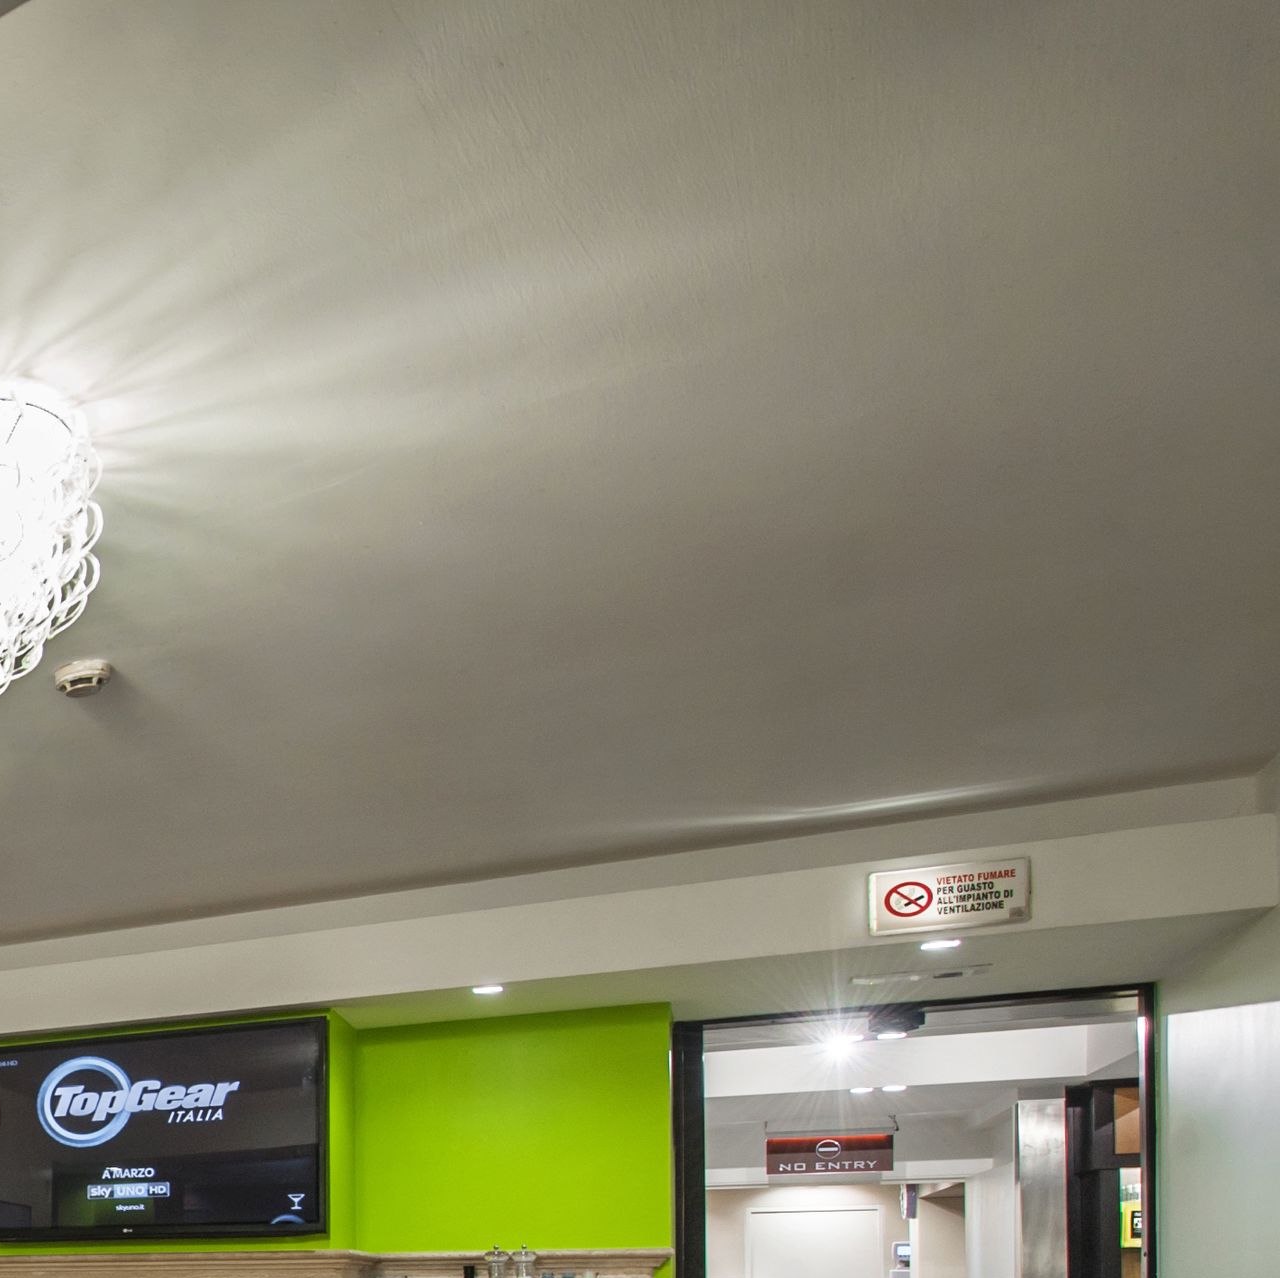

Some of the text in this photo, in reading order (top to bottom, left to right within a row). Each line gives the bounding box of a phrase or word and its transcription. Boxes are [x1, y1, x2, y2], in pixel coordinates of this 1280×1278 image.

[936, 868, 1017, 886] VIETATO FUMARE
[937, 881, 994, 895] PER GUASTO
[937, 889, 1014, 905] ALL'IMPIANTO DI
[937, 900, 1005, 915] VENTILAZIONE
[167, 1108, 224, 1124] ITALIA
[779, 1160, 877, 1171] NO ENTRY
[112, 1167, 155, 1179] MARZO
[90, 1185, 167, 1199] sky UNO HD
